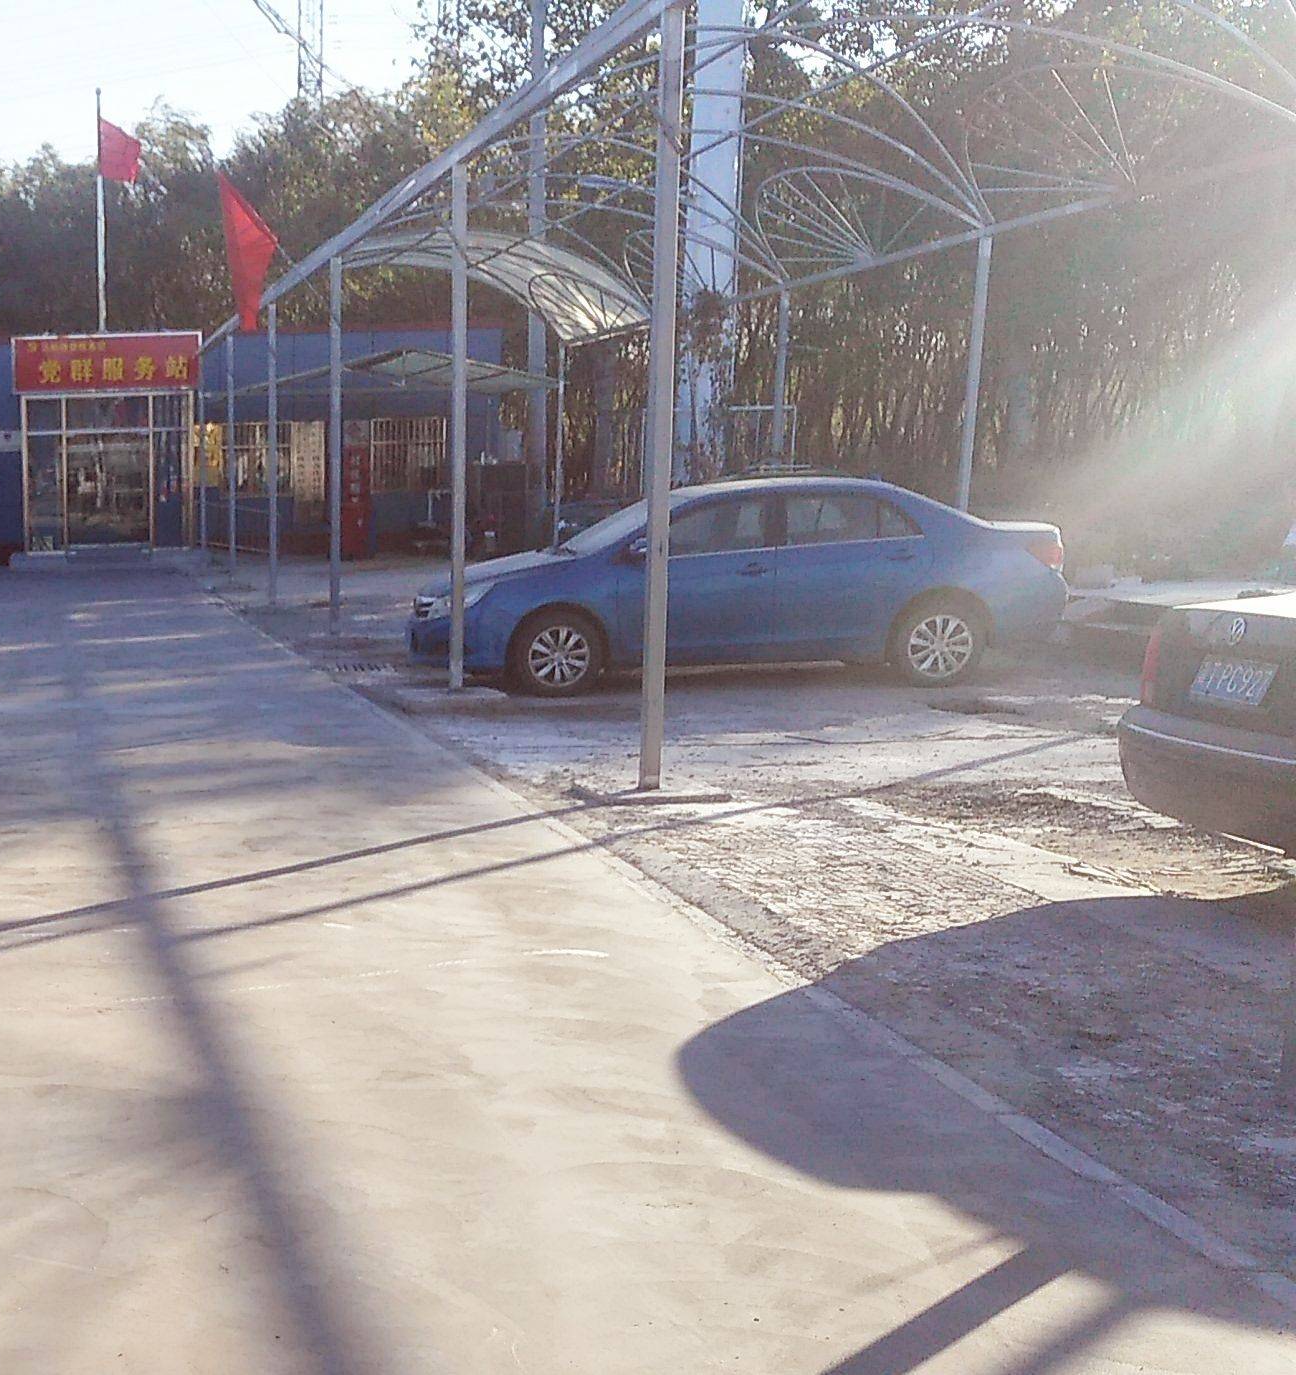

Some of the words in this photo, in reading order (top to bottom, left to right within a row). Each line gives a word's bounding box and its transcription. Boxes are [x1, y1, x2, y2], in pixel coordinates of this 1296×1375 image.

[39, 355, 189, 383] 党群服务站
